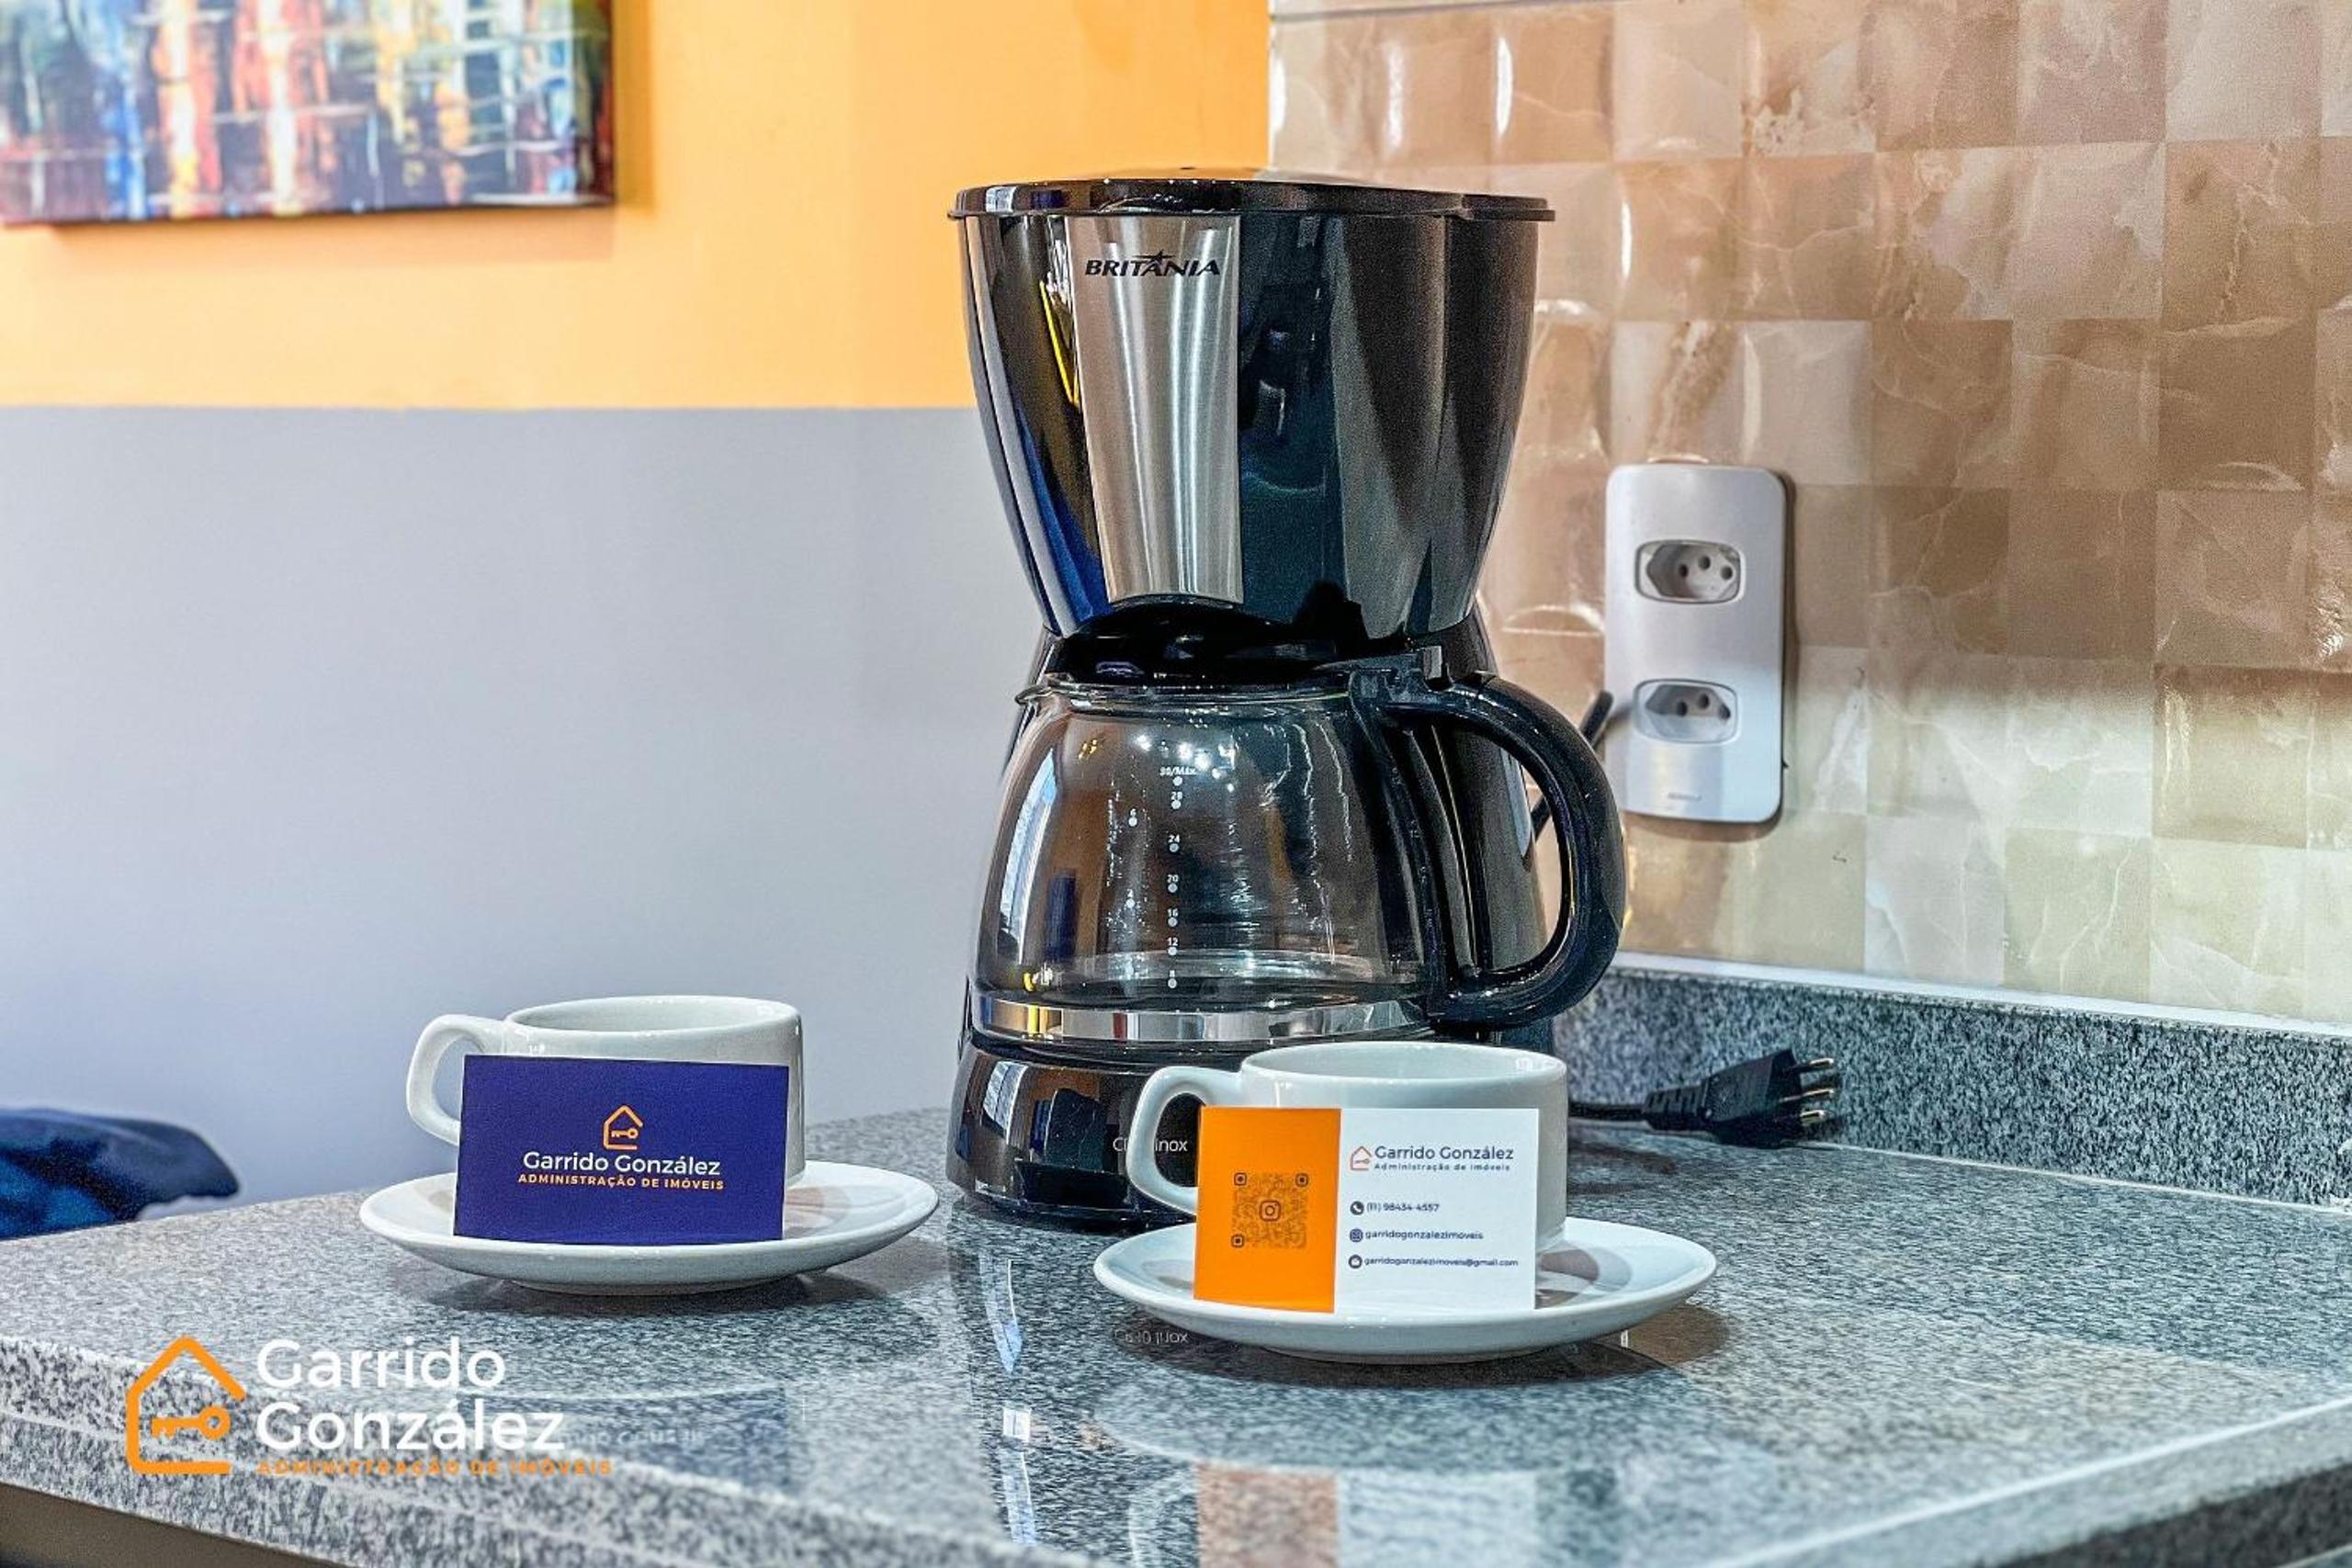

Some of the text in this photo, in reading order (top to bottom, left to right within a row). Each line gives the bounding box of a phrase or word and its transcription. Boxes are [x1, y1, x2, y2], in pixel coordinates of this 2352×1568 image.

[1168, 834, 1180, 843] 24
[1167, 874, 1179, 883] 20
[1167, 908, 1179, 917] 16
[1167, 937, 1179, 946] 12
[1374, 1145, 1515, 1160] Garrido González
[522, 1151, 721, 1176] Garrido González
[1453, 1162, 1466, 1171] de
[517, 1173, 724, 1190] ADMINISTRAÇÃO DE IMÓVEIS
